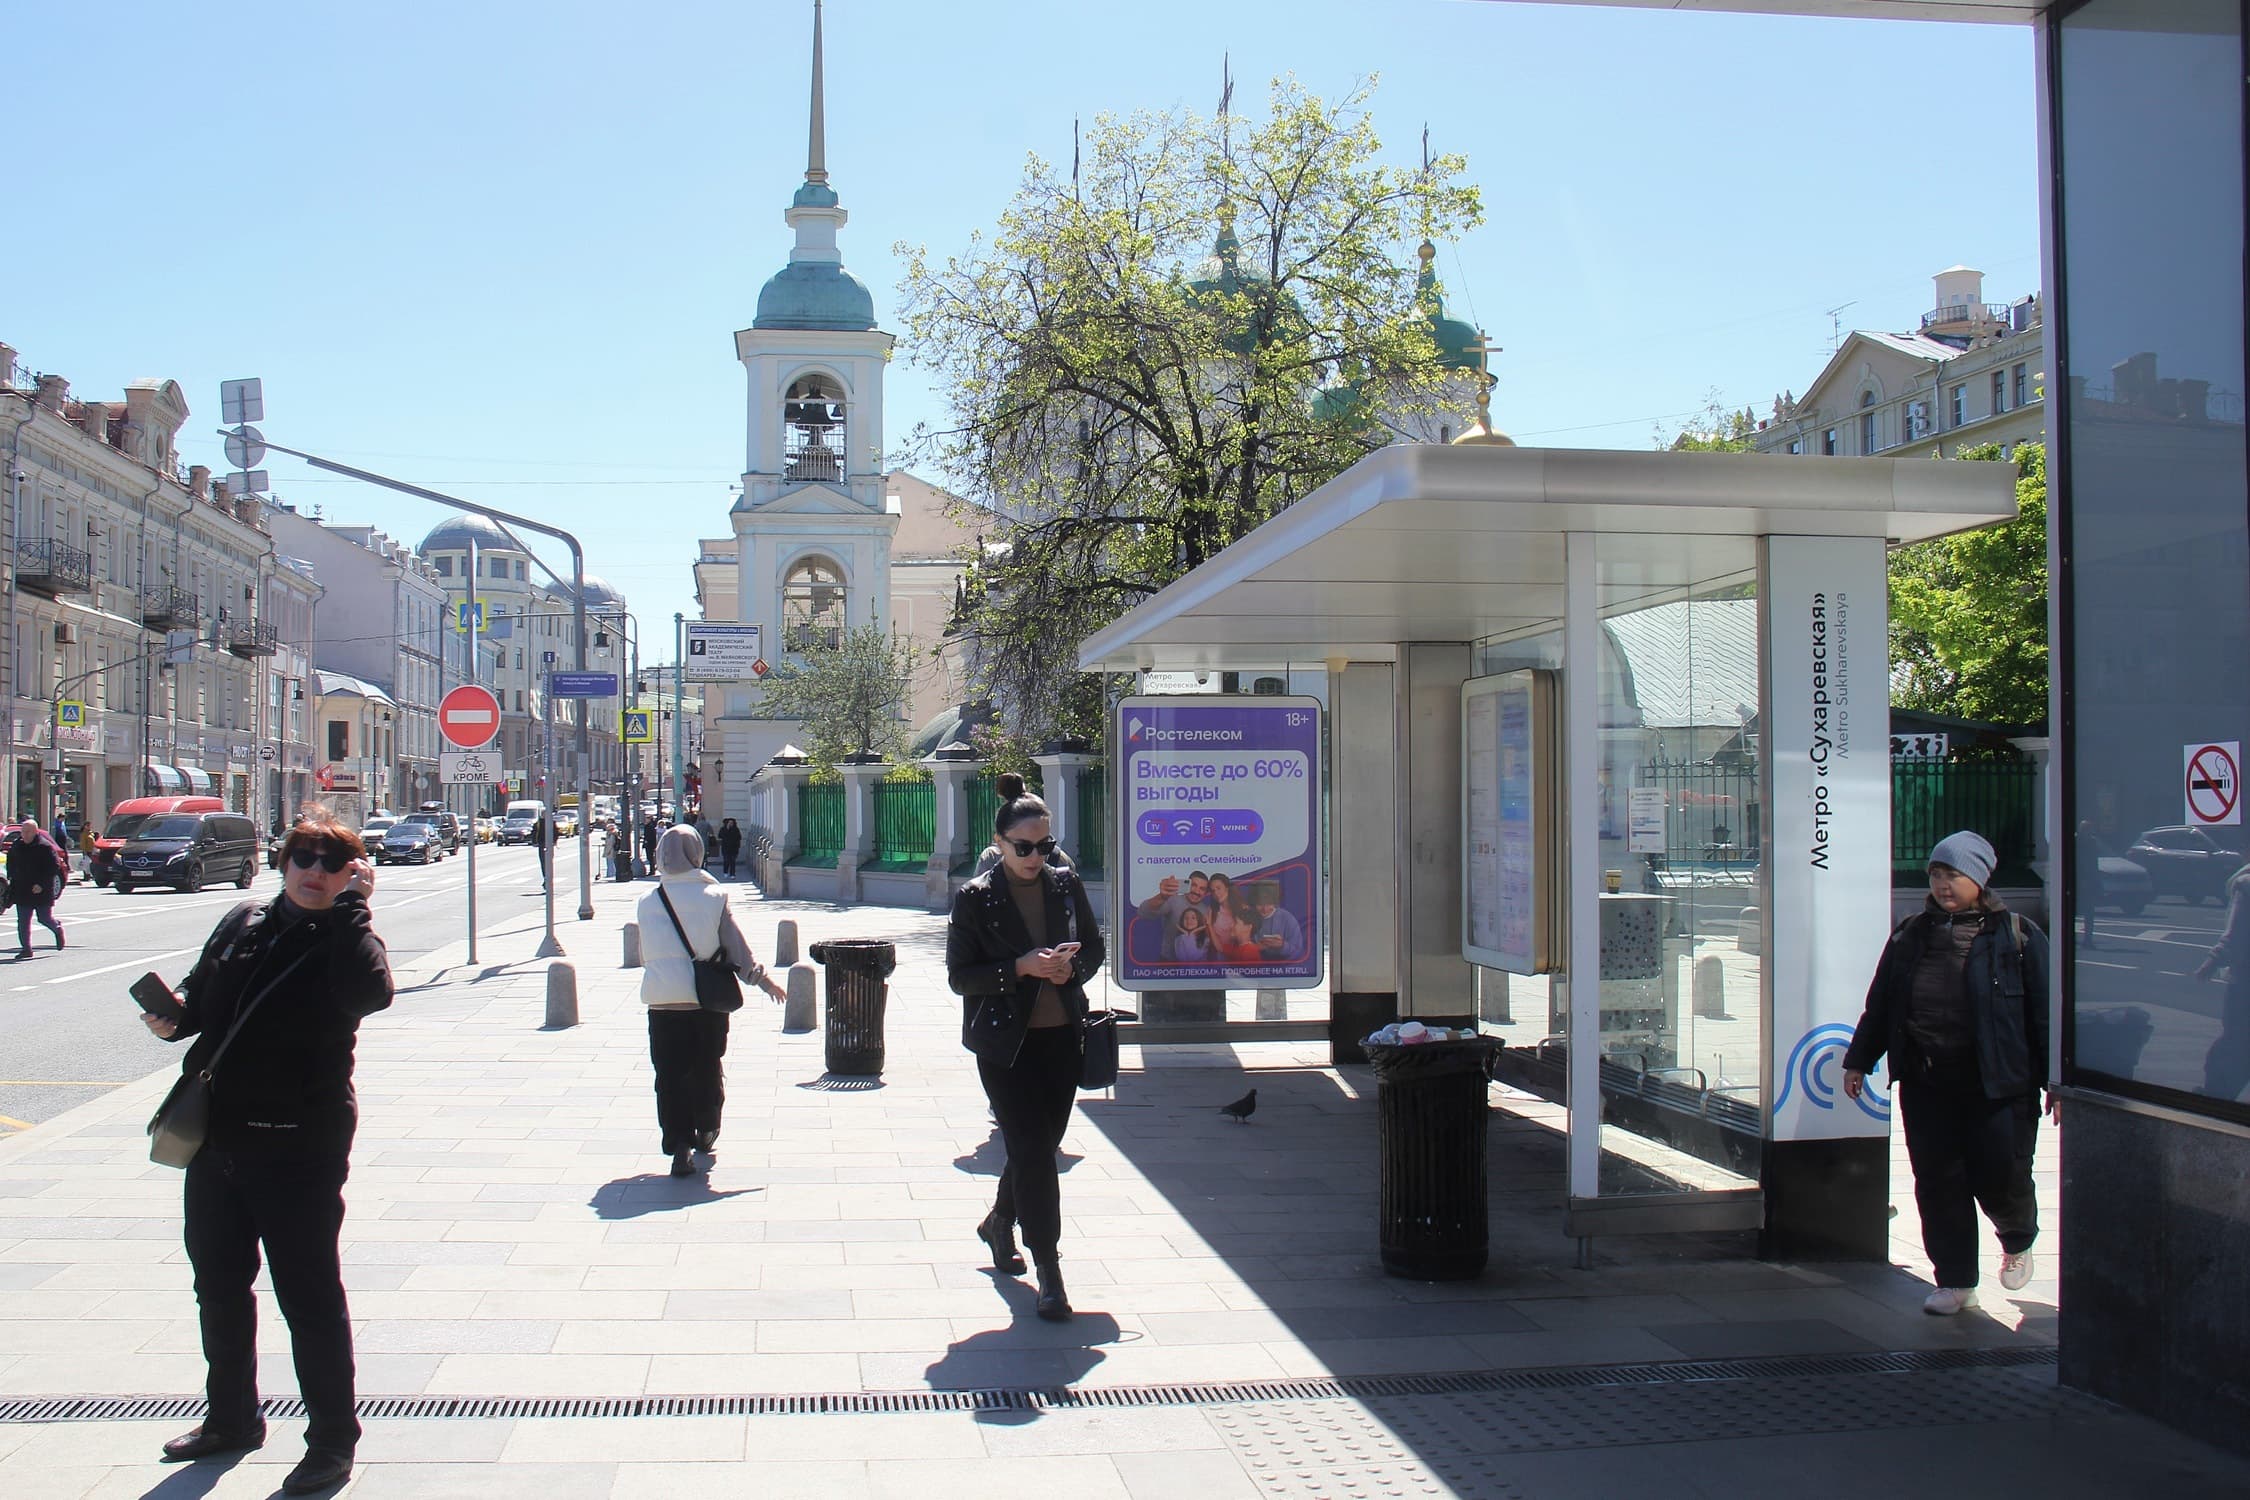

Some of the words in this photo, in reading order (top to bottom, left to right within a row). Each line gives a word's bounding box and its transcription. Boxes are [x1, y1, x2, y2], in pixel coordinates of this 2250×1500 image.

[1834, 592, 1848, 706] Sukharevskaya
[1145, 673, 1172, 681] Метро
[1810, 592, 1832, 777] «Сухаревская»
[1285, 712, 1309, 727] 18+
[1145, 727, 1243, 741] Ростелеком
[1835, 710, 1849, 759] Metro
[453, 773, 489, 781] КРОМЕ
[1136, 760, 1216, 779] Вместе
[1220, 764, 1249, 781] до
[1254, 759, 1303, 779] 60%
[1136, 786, 1219, 803] выгоды
[1810, 785, 1832, 870] Метро
[1137, 856, 1144, 865] с
[1146, 856, 1191, 864] пакетом
[1194, 854, 1262, 864] «Семейный»
[1132, 968, 1150, 977] ПАО
[1221, 967, 1270, 976] ПОДРОБНЕЕ
[1272, 967, 1283, 975] НА
